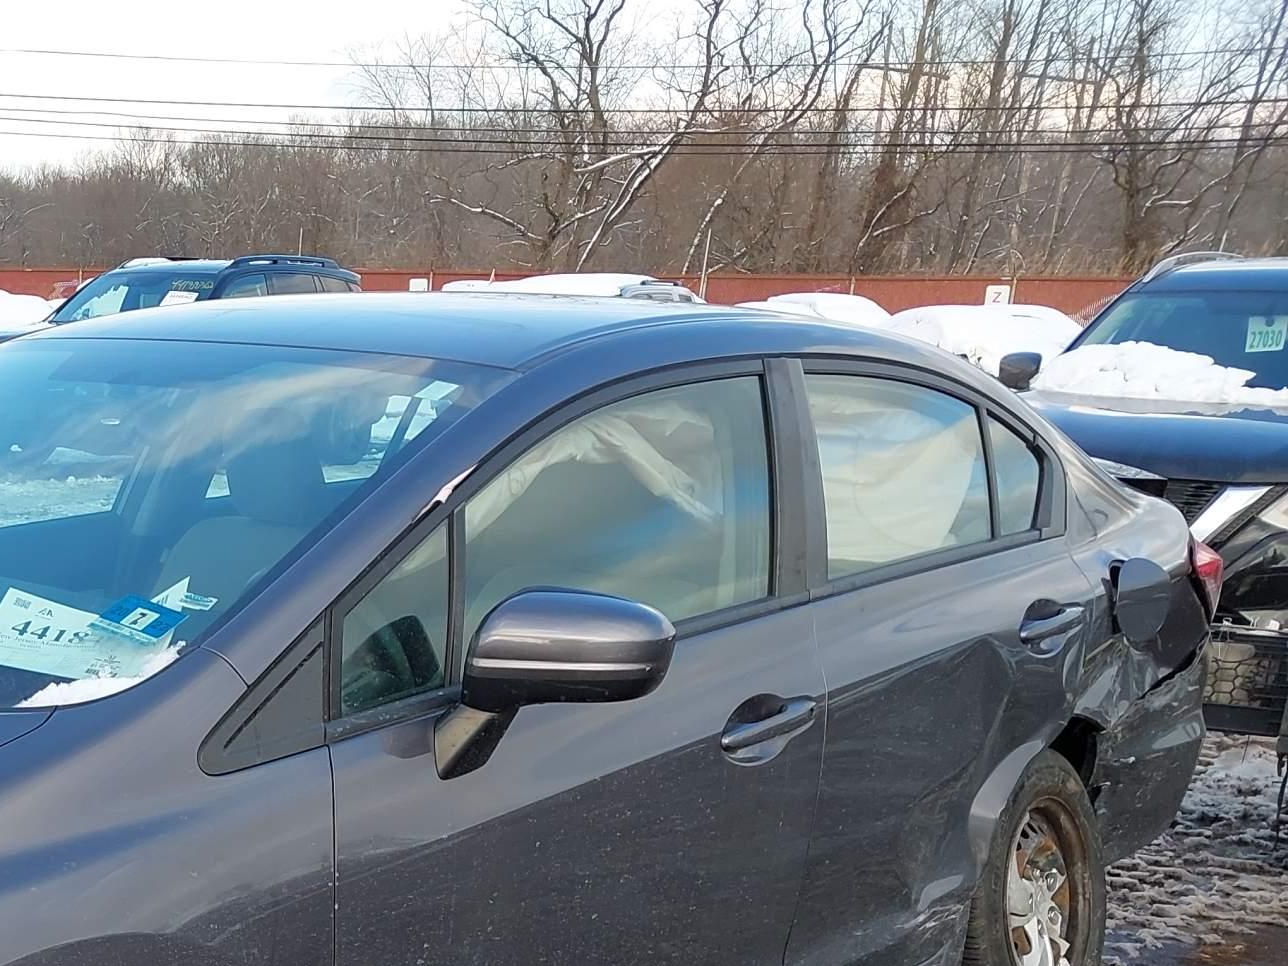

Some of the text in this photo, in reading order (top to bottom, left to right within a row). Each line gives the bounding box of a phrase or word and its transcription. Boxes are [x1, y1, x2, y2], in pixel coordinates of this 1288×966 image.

[992, 291, 1002, 303] Z
[1249, 330, 1282, 349] 27030
[129, 612, 148, 626] 7
